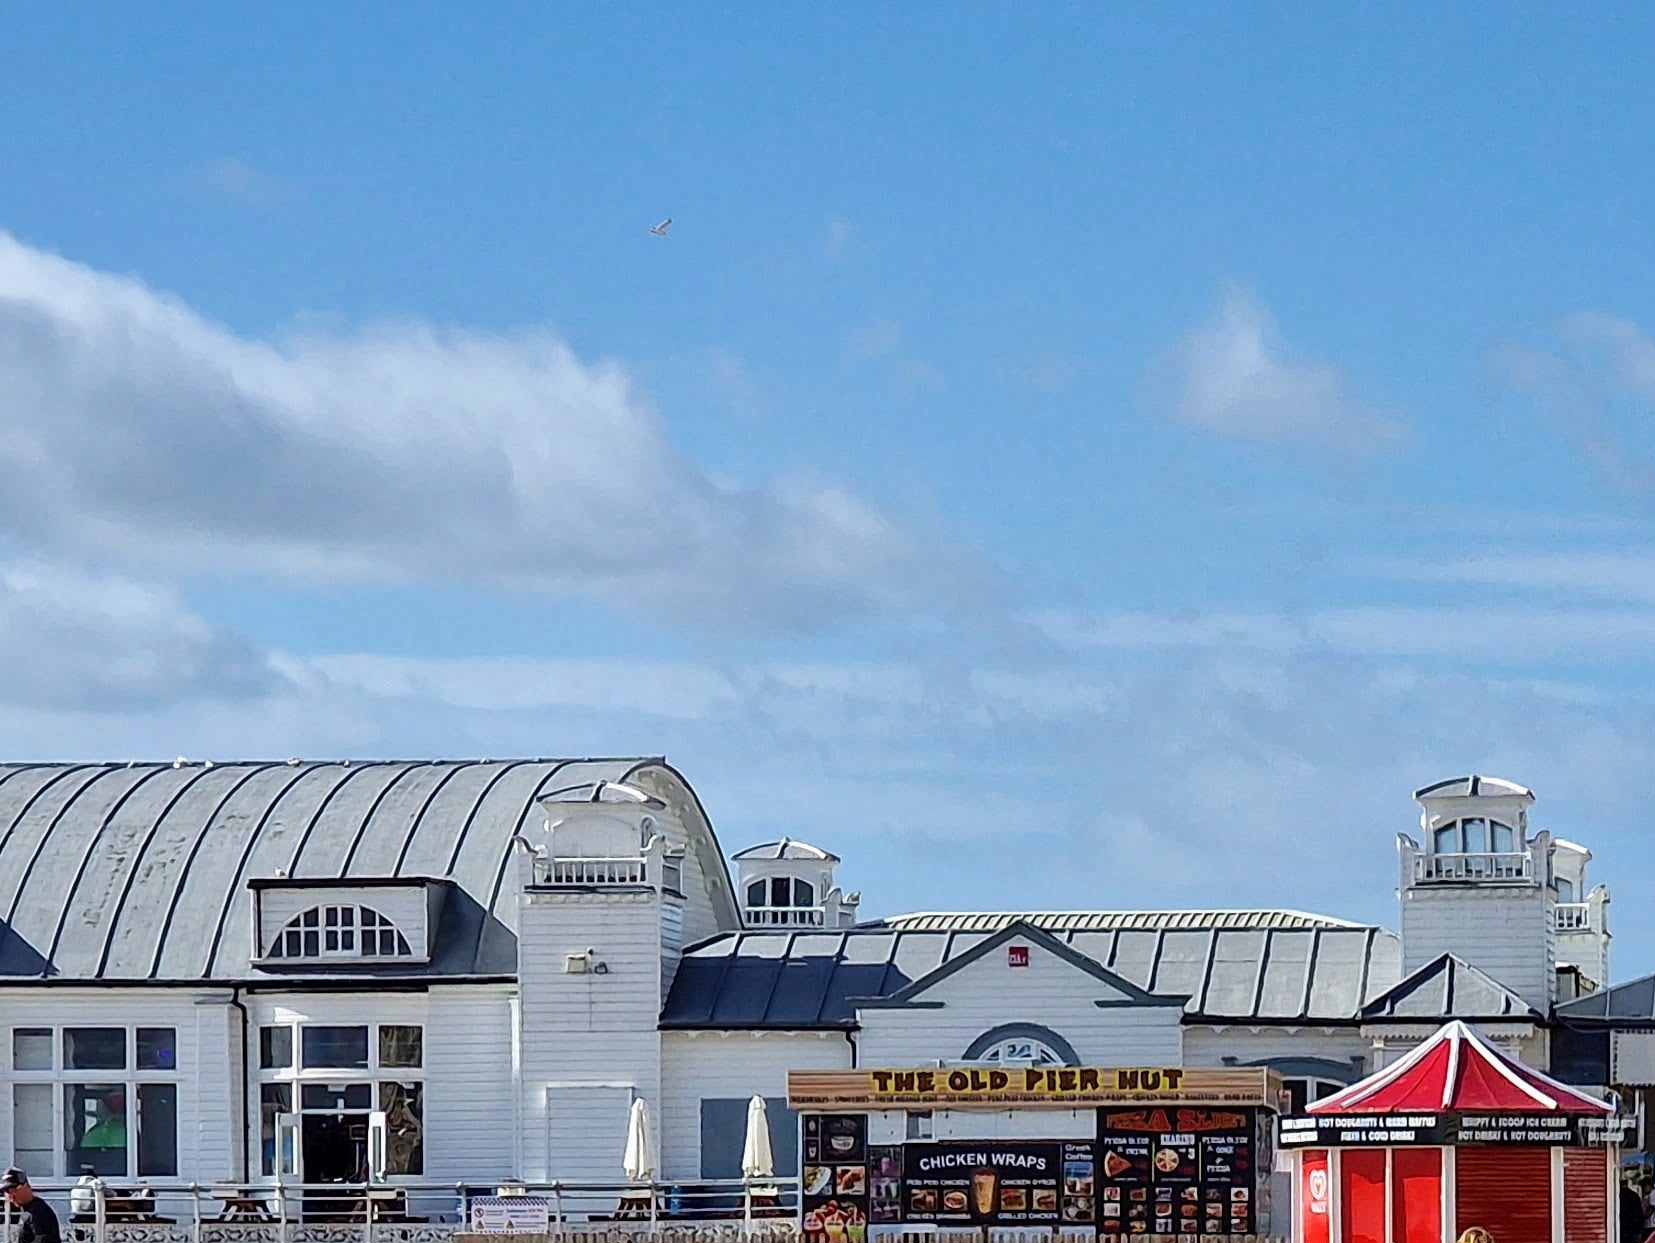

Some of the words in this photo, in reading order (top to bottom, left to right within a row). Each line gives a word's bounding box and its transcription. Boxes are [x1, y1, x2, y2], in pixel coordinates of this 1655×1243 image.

[873, 1071, 936, 1092] THE
[949, 1070, 1008, 1091] OLD
[1025, 1069, 1100, 1091] PIER
[1118, 1069, 1184, 1090] HUT
[920, 1153, 987, 1170] CHICKEN
[991, 1153, 1047, 1170] WRAPS
